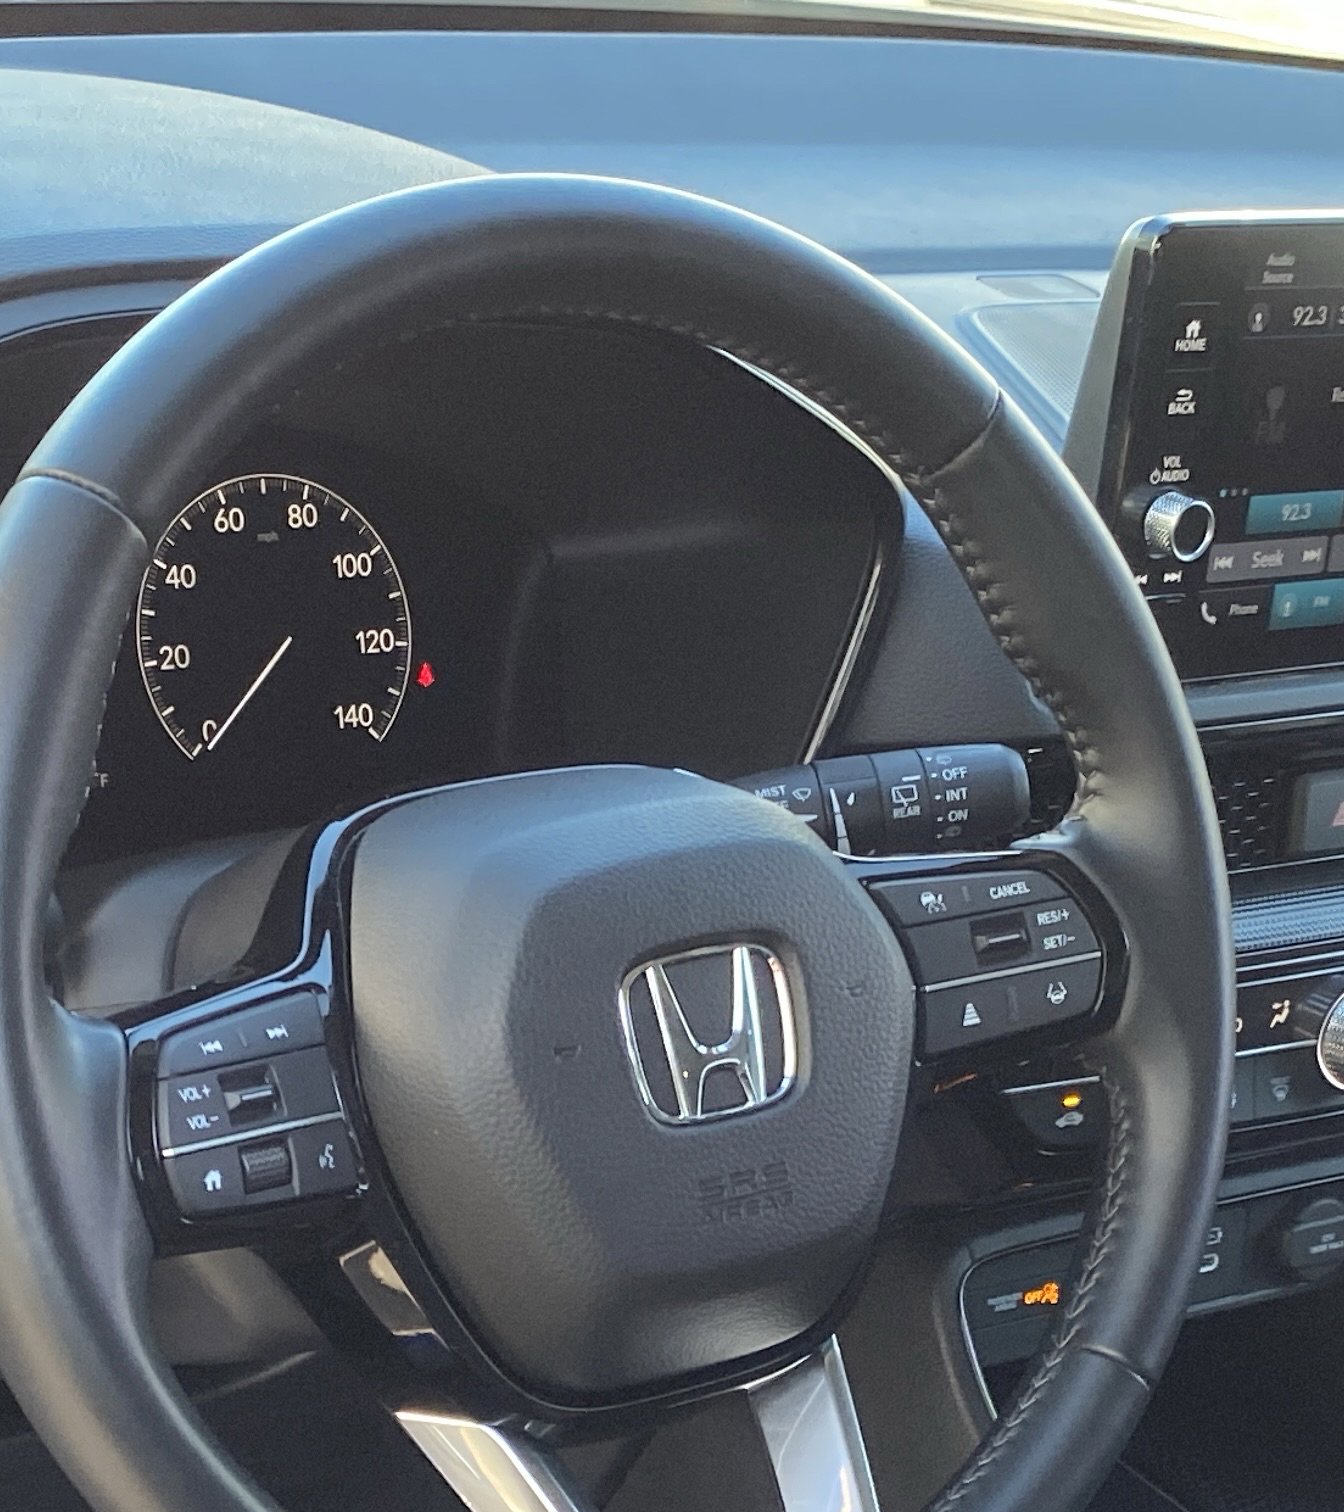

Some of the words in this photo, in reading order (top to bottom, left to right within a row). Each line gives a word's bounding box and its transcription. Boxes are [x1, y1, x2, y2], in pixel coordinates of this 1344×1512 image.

[1291, 306, 1328, 327] 92.3
[1174, 338, 1207, 352] HOME
[1167, 401, 1197, 415] BACK
[1162, 455, 1182, 468] VOL
[1161, 468, 1191, 482] AUDIO
[213, 507, 245, 533] 60
[287, 502, 318, 529] 80
[1280, 502, 1313, 522] 92.3
[332, 552, 373, 580] 100
[1250, 548, 1284, 569] Seek
[164, 563, 197, 590] 40
[355, 628, 395, 655] 120
[158, 644, 191, 671] 20
[333, 702, 374, 730] 140
[941, 766, 968, 782] OFF
[945, 786, 968, 803] INT
[893, 805, 921, 819] REAR
[947, 808, 969, 822] ON
[989, 880, 1031, 900] CANCEL
